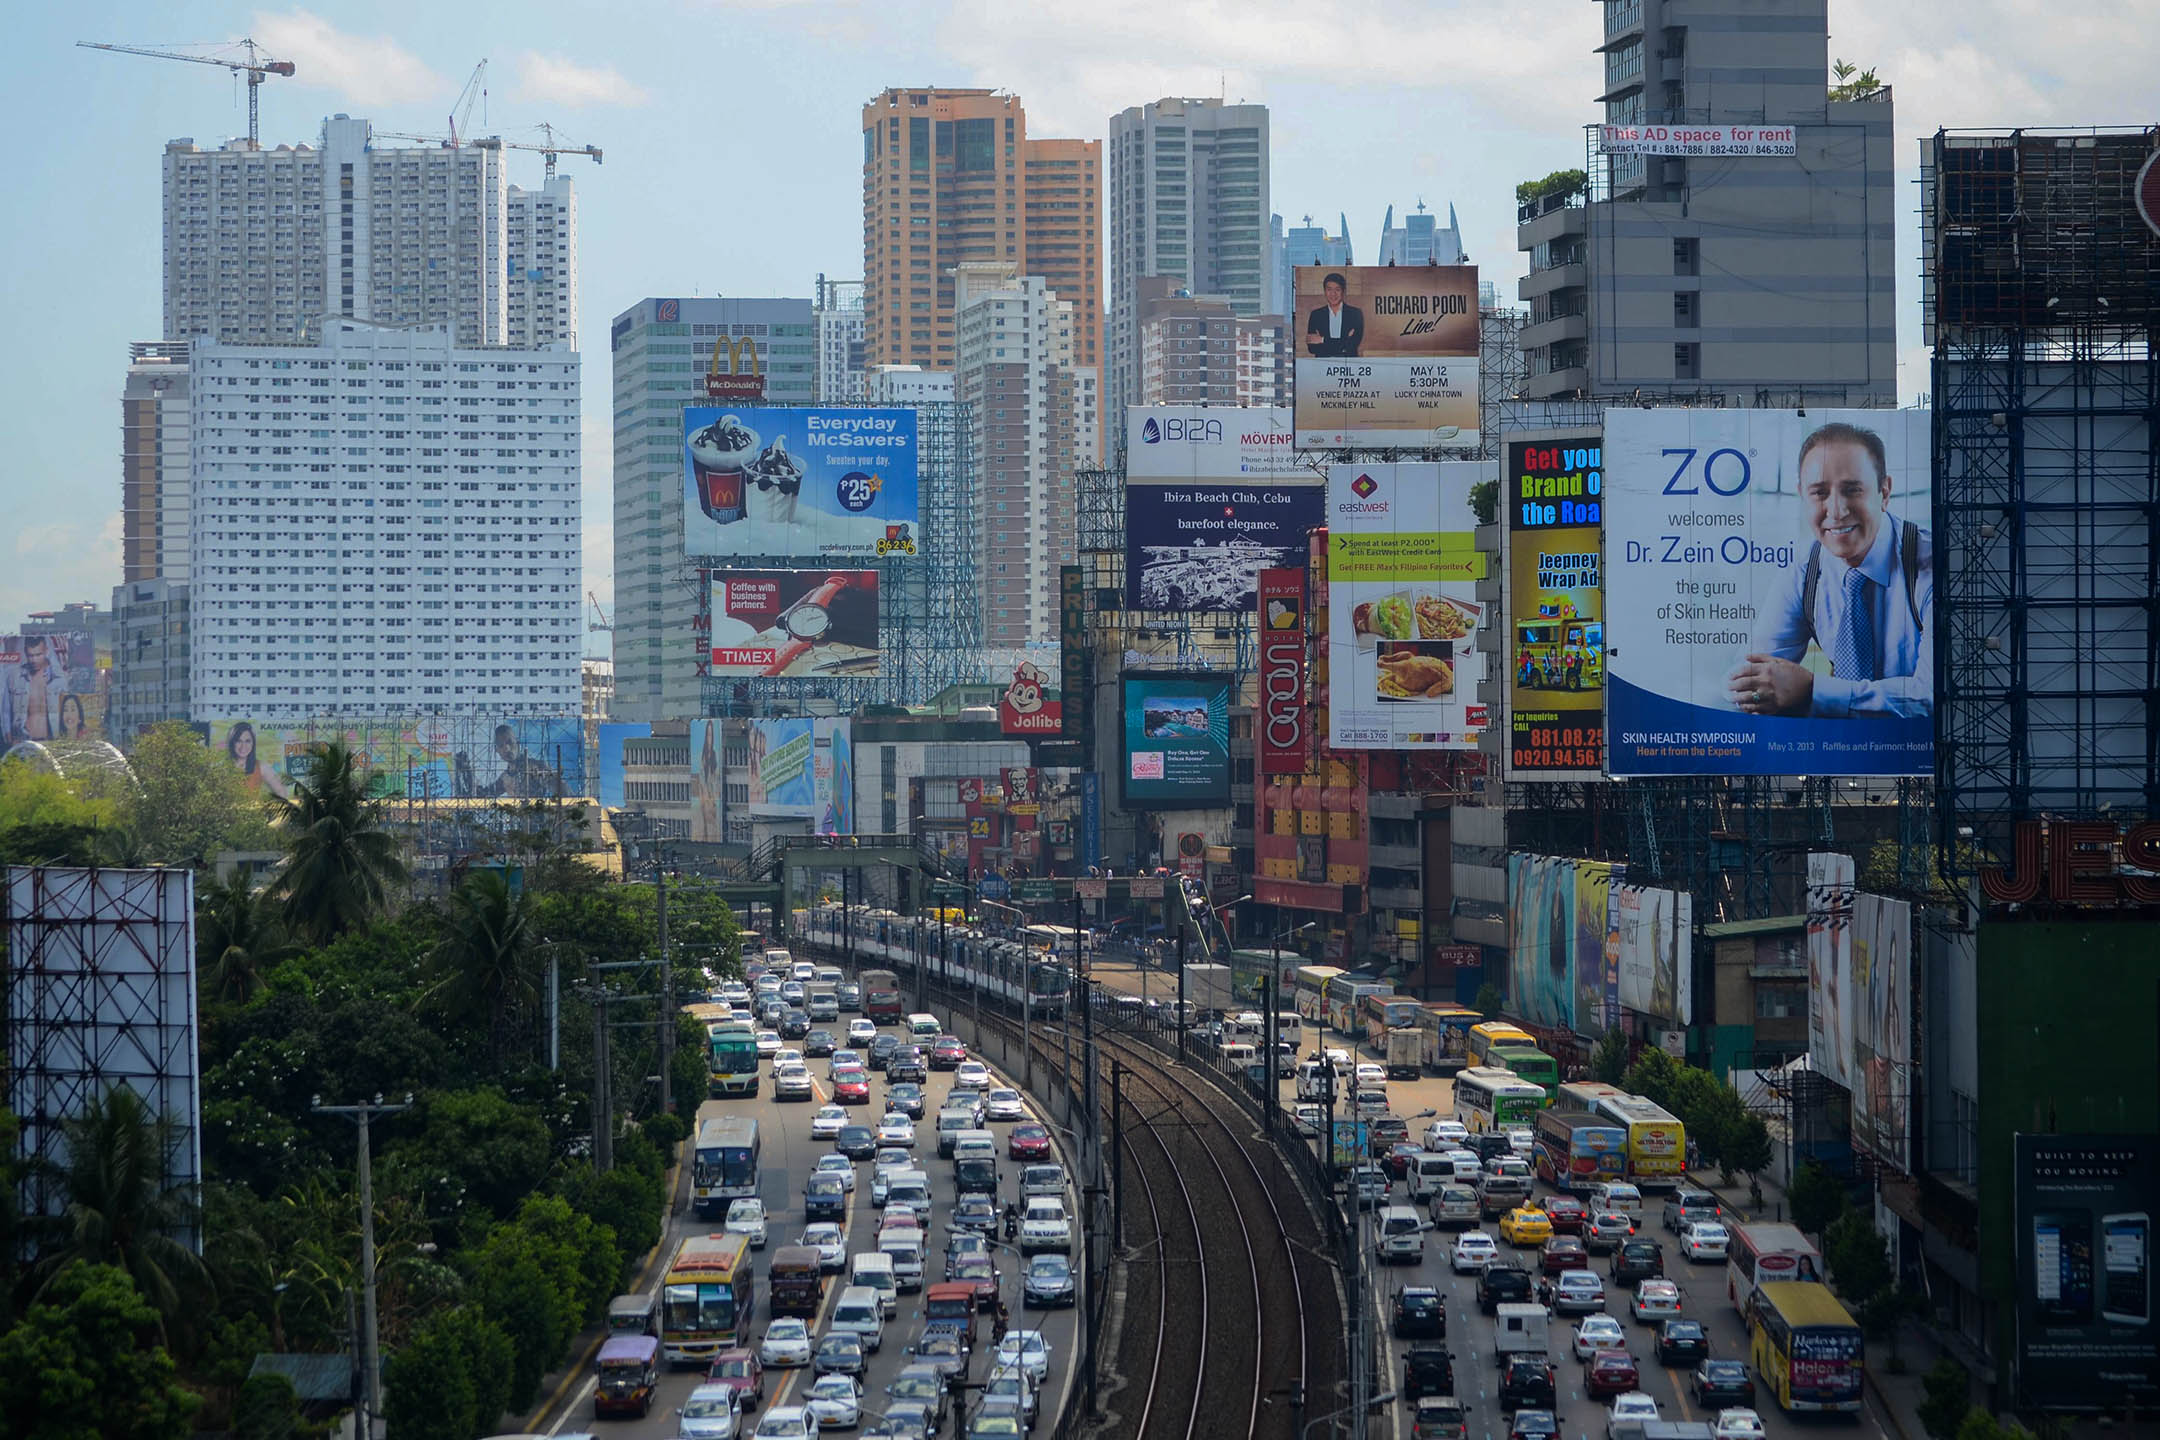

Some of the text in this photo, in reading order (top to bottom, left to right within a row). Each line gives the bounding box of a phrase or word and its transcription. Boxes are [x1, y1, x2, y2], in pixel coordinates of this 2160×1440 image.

[1604, 127, 1791, 144] This AD space for rent
[1600, 143, 1635, 154] Contact
[1636, 143, 1650, 153] Tel
[1710, 145, 1748, 155] 882-4320
[1755, 145, 1794, 155] 846-3620
[1375, 295, 1467, 315] RICHARD POON
[1400, 315, 1444, 336] Live!
[1326, 366, 1372, 377] APRIL 28
[1410, 366, 1447, 376] MAY 12
[710, 380, 761, 390] McDonald's
[1338, 378, 1361, 388] 7PM
[1409, 378, 1449, 388] 5:30PM
[1320, 401, 1376, 409] MCKINLEY HILL
[1417, 401, 1439, 409] WALK
[807, 416, 896, 433] Everyday
[1163, 418, 1223, 441] IBIZA
[807, 433, 906, 447] McSavers
[826, 455, 891, 467] Sweeten your day.
[1525, 448, 1600, 470] Get you
[1521, 472, 1583, 498] Brand
[849, 500, 864, 508] each
[1164, 492, 1291, 504] Ibiza Beach Club, Cebu
[1338, 500, 1389, 513] eastwest
[1522, 500, 1600, 525] the Roa
[1178, 518, 1280, 532] barefoot elegance.
[1668, 511, 1745, 527] welcomes
[1348, 539, 1371, 548] Spend
[1381, 539, 1399, 547] least
[1348, 549, 1365, 557] with
[1626, 535, 1794, 568] Dr. Zein Obagi
[1338, 563, 1353, 572] Get
[1354, 563, 1375, 571] FREE
[1400, 563, 1428, 572] Filipino
[1429, 562, 1465, 571] Favorites
[1538, 552, 1598, 570] Jeepney
[1538, 571, 1577, 589] Wrap
[731, 583, 776, 592] Coffee with
[1676, 579, 1736, 598] the guru
[731, 591, 767, 601] business
[731, 601, 767, 611] partners.
[1657, 603, 1756, 620] of Skin Health
[1665, 628, 1748, 645] Restoration
[722, 651, 773, 664] TIMEX
[1063, 573, 1083, 737] PRINCESS
[1013, 714, 1062, 728] Jollibe
[1513, 712, 1559, 722] For Inquiries
[1513, 723, 1529, 731] CALL
[1622, 733, 1756, 744] SKIN HEALTH SYMPOSIUM
[1636, 746, 1658, 757] Hear
[1668, 746, 1688, 757] from
[1691, 746, 1705, 757] the
[1707, 746, 1742, 757] Experts
[1767, 742, 1786, 753] May
[1787, 742, 1795, 752] 3,
[1796, 742, 1815, 752] 2013
[1822, 742, 1850, 753] Raffles
[1852, 742, 1868, 752] and
[1906, 742, 1928, 753] Hotel
[970, 821, 990, 835] 24
[2036, 1152, 2072, 1160] BUILT
[2080, 1152, 2095, 1160] TO
[2036, 1168, 2061, 1176] YOU
